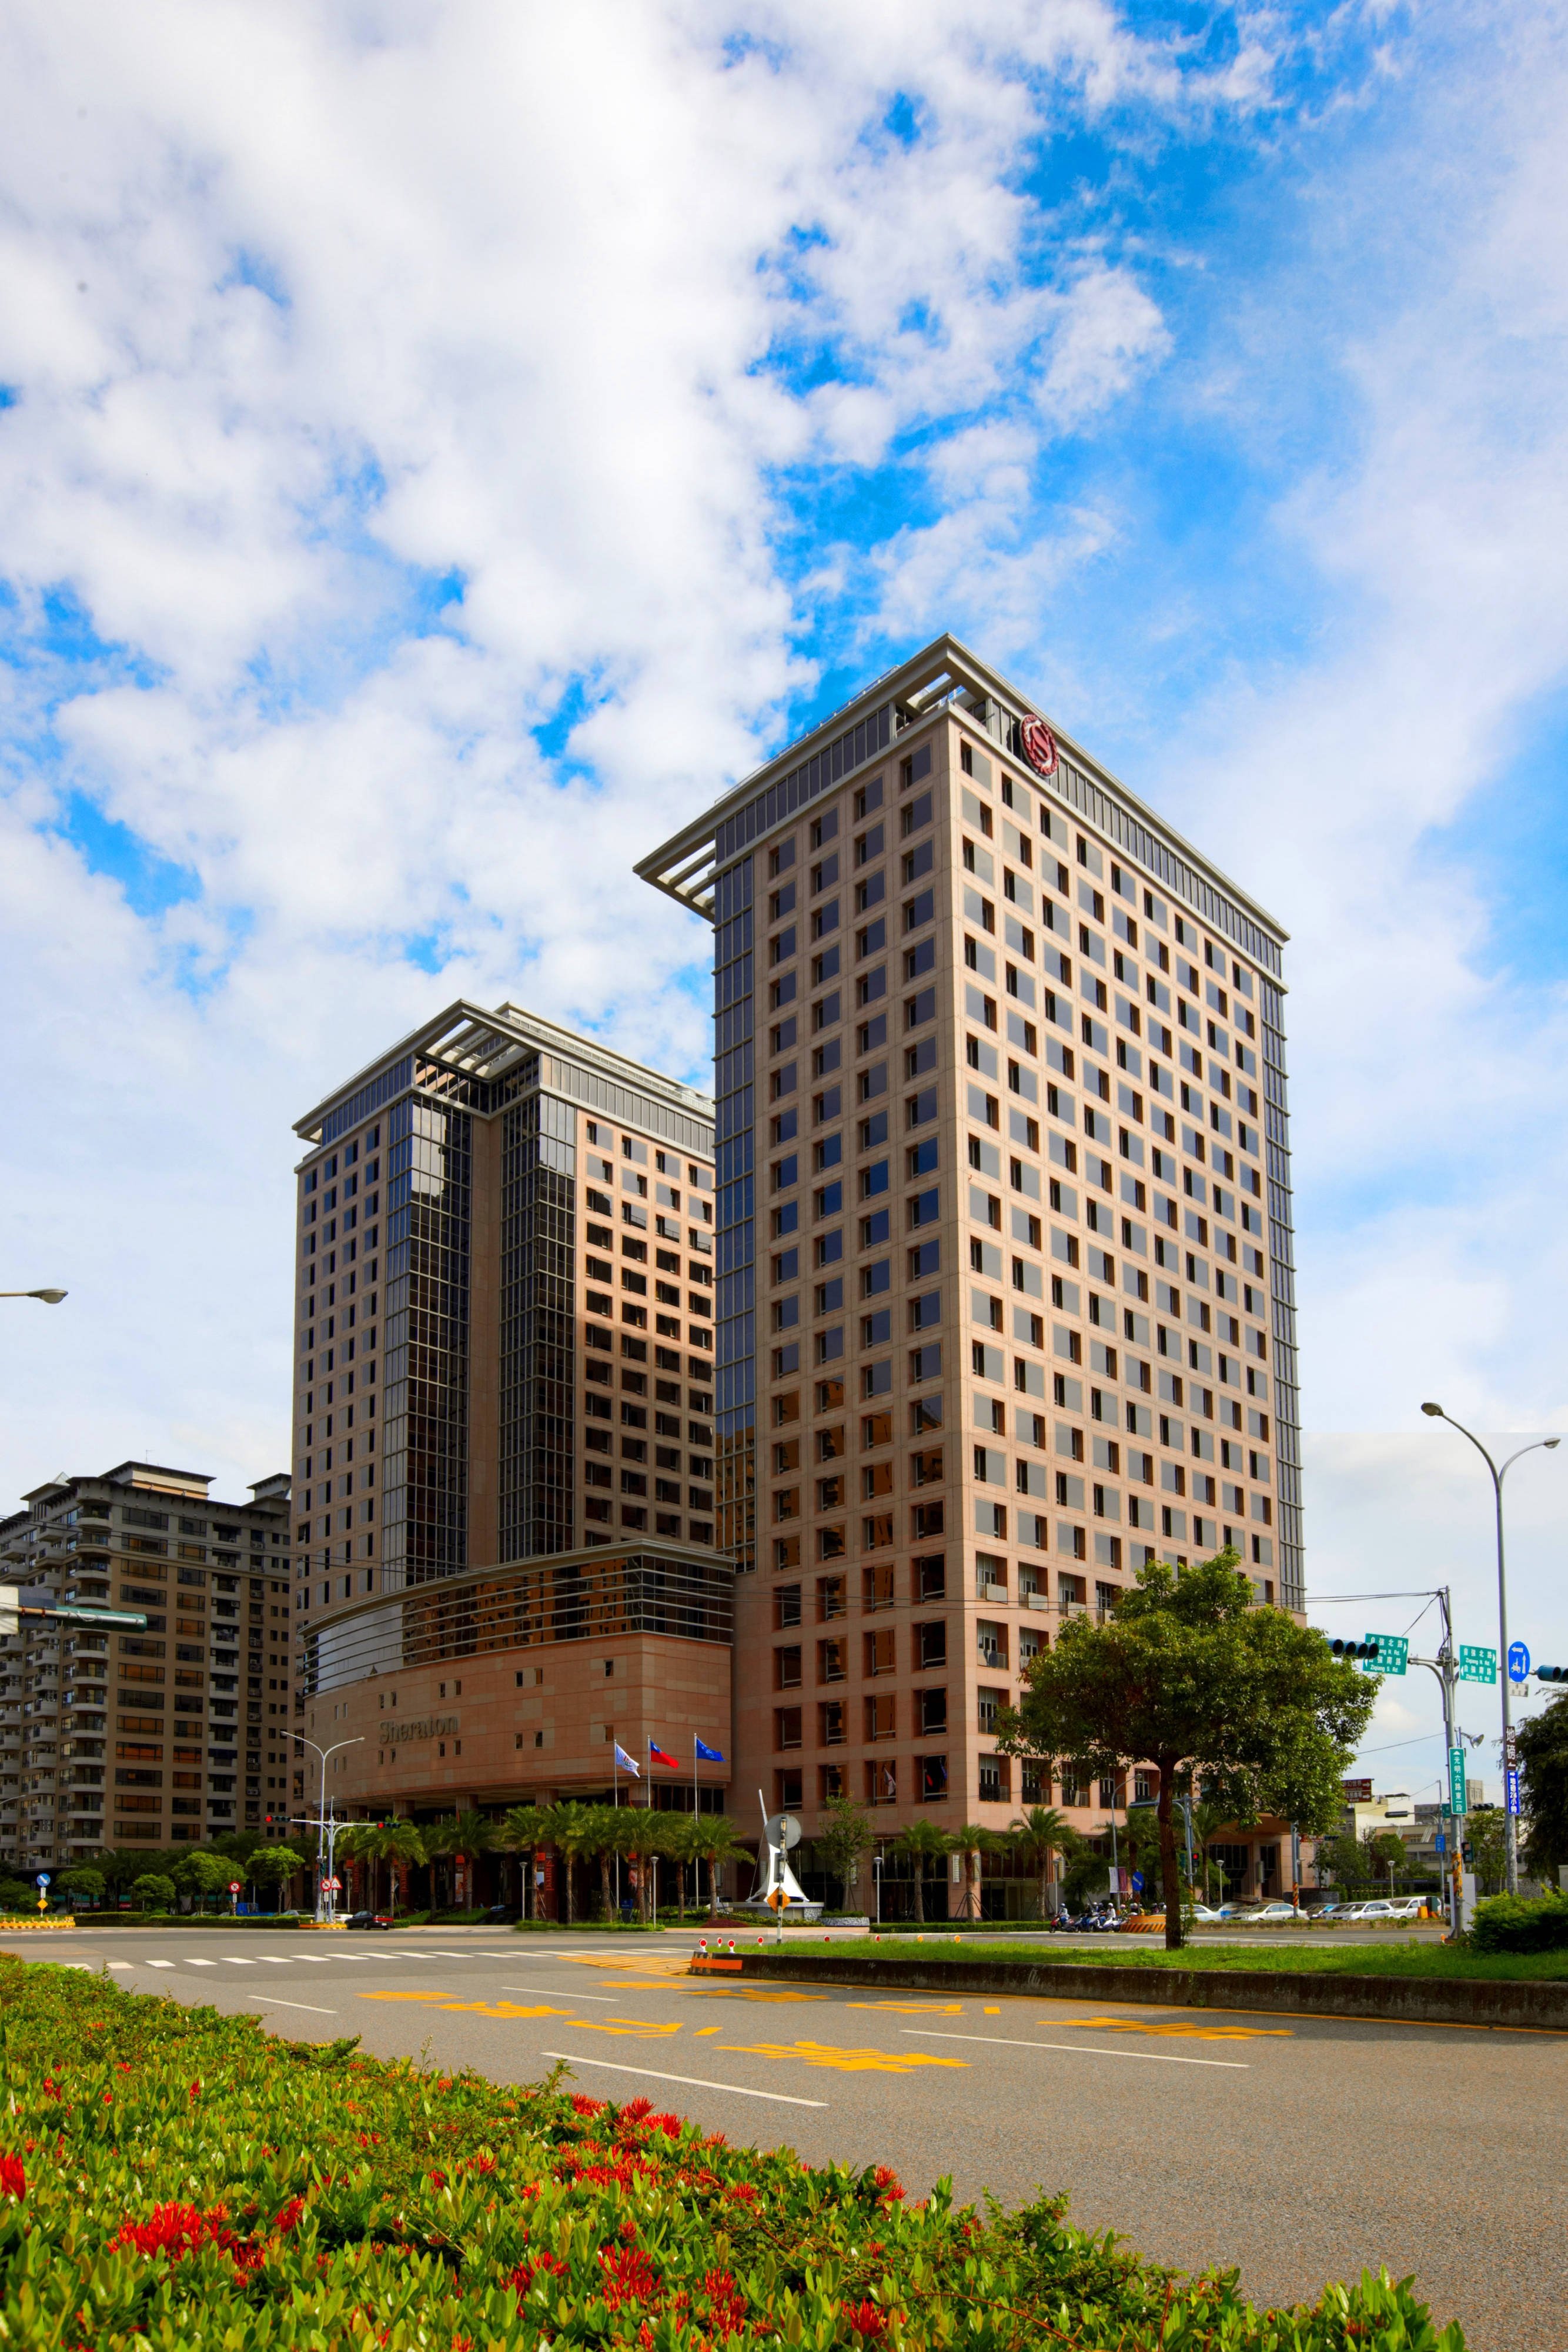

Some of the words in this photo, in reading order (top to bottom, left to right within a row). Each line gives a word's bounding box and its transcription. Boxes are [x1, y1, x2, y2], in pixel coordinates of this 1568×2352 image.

[1464, 1648, 1492, 1658] 自強北路
[379, 1716, 459, 1744] Sheraton
[1454, 1756, 1463, 1812] 光明六路東一段
